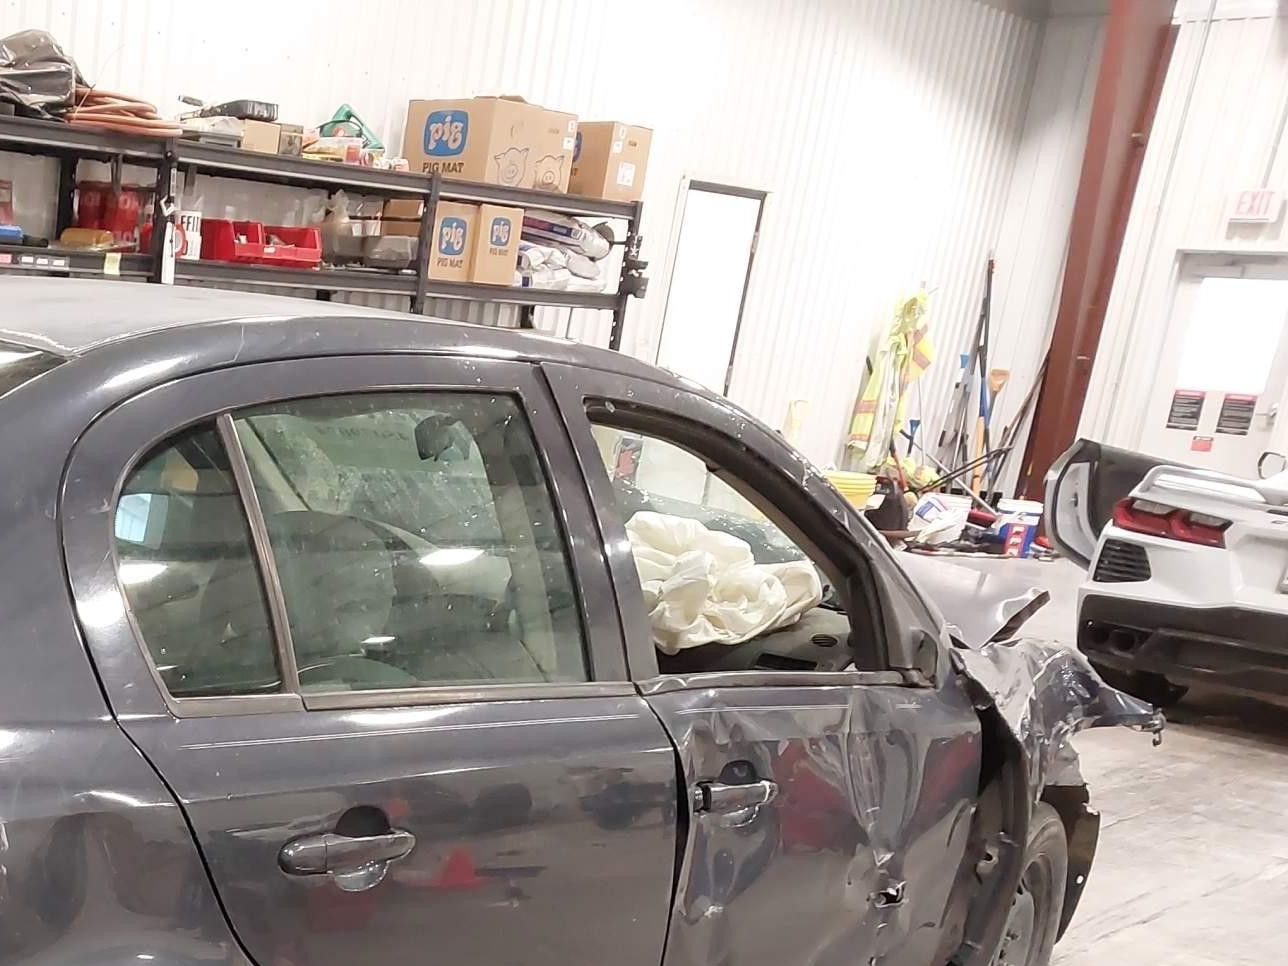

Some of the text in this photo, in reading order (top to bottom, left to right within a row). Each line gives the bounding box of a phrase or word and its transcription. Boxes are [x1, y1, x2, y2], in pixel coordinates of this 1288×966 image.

[428, 115, 464, 150] pig
[422, 162, 464, 174] PIG MAT
[1235, 191, 1273, 217] EXIT
